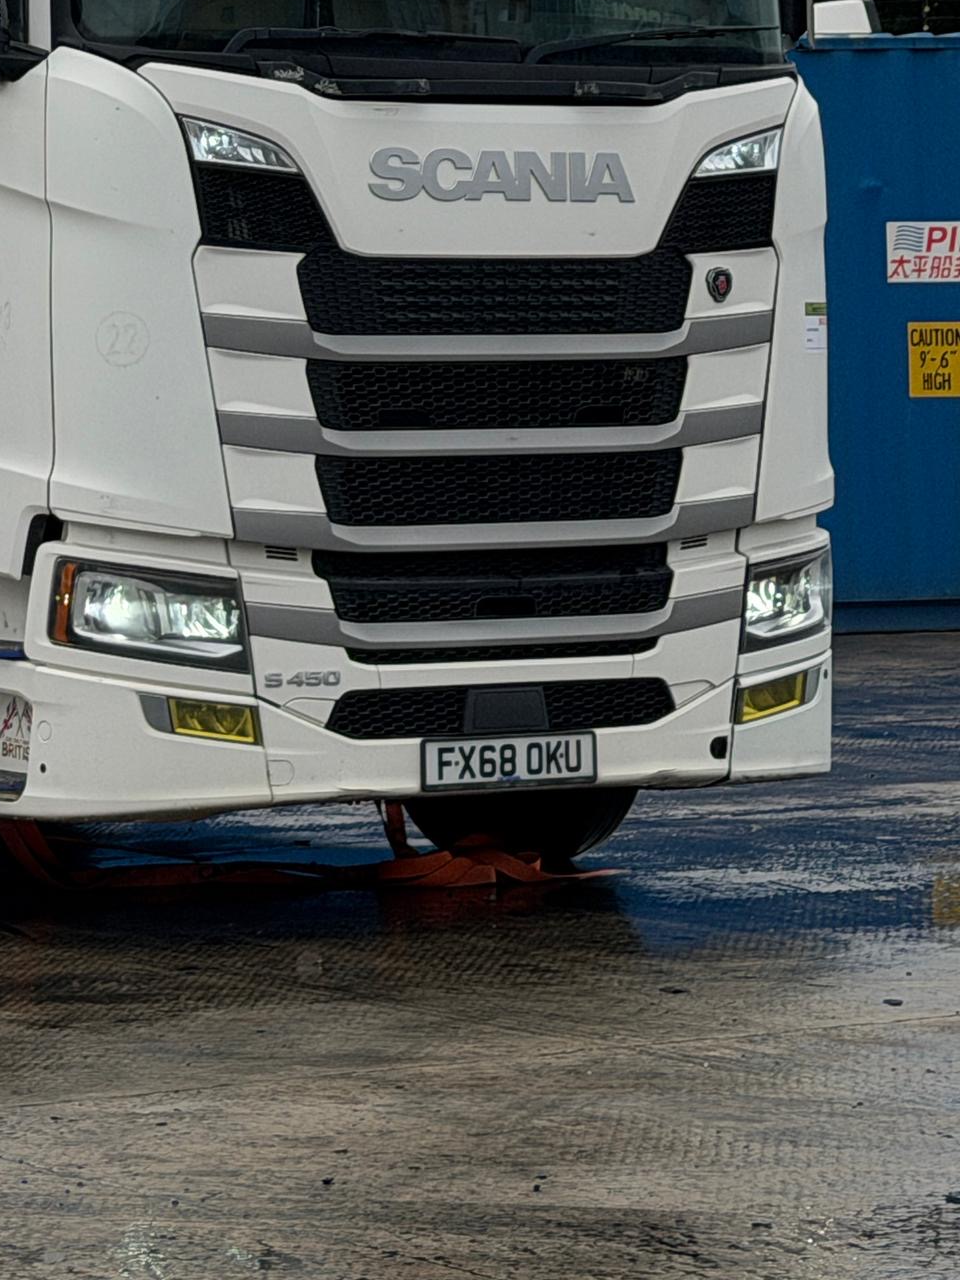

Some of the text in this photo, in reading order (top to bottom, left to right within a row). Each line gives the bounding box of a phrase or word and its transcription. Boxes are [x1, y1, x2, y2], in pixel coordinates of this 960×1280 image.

[367, 147, 636, 203] SCANIA
[925, 225, 960, 253] PI
[923, 372, 952, 391] HIGH
[263, 671, 342, 689] S 450
[437, 739, 582, 781] FX68 OKU
